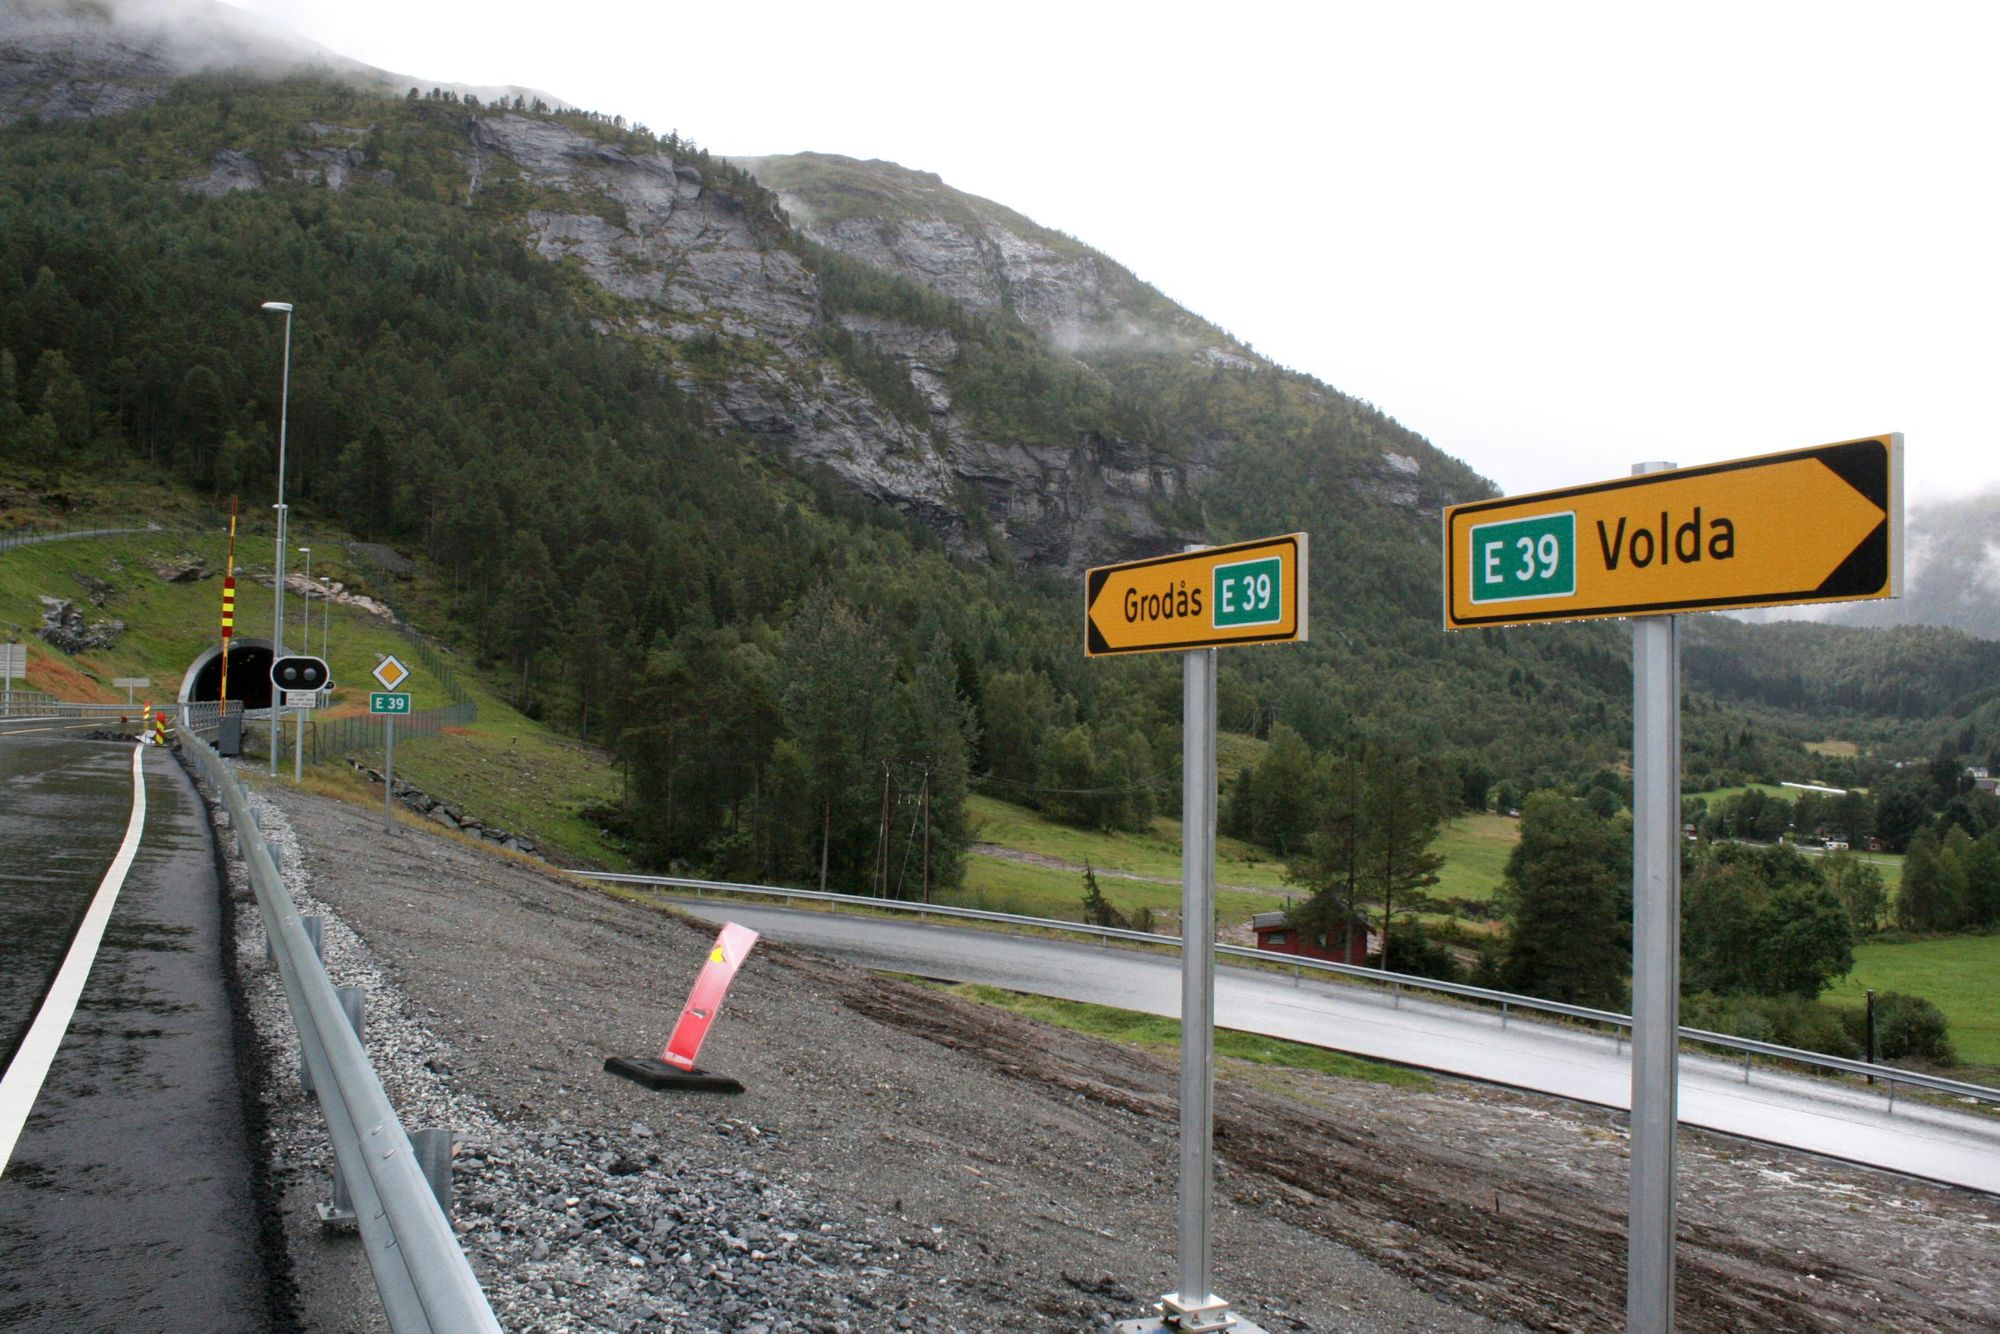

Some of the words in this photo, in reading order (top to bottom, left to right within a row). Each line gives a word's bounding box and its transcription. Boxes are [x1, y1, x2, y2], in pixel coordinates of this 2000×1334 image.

[1485, 541, 1503, 584] E
[1515, 534, 1559, 581] 39
[1596, 506, 1735, 571] Volda
[1124, 580, 1202, 623] Grodås
[1222, 579, 1235, 613] E
[1242, 573, 1271, 611] 39
[376, 697, 384, 709] E
[387, 697, 404, 710] 39
